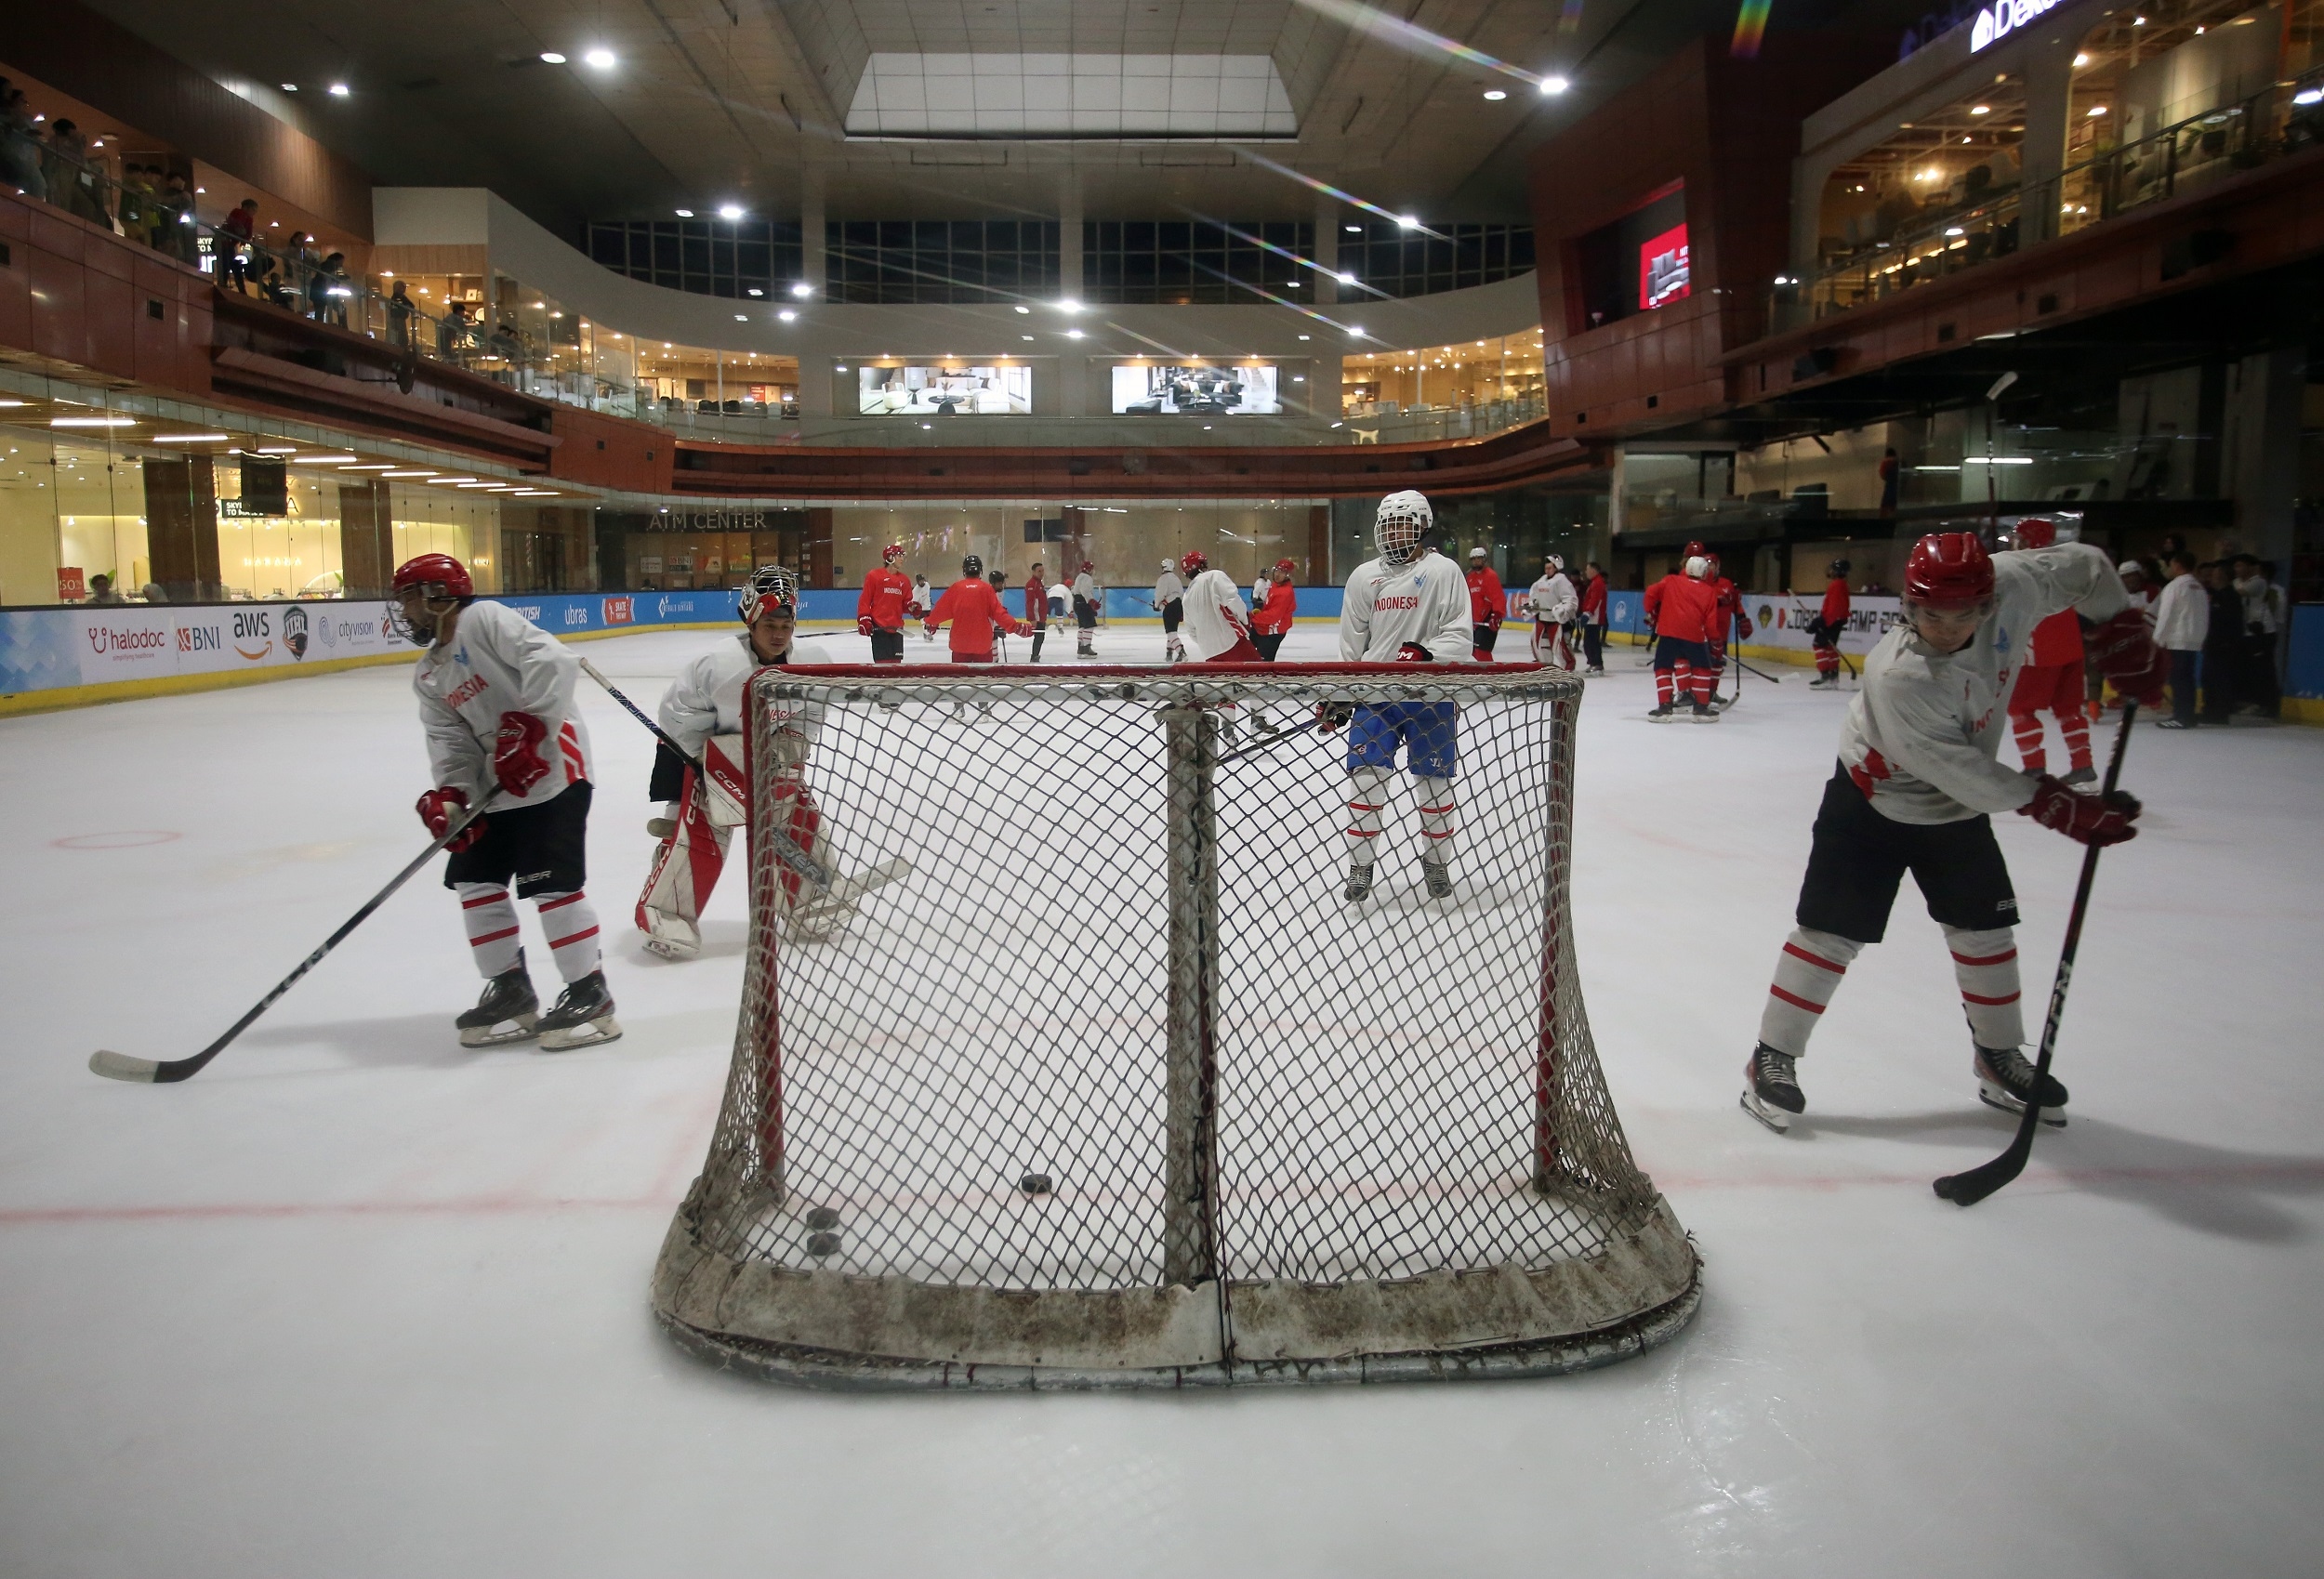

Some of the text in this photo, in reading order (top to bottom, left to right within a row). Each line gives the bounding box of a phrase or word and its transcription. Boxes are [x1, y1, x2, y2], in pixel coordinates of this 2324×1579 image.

[649, 512, 767, 530] ATM CENTER
[233, 612, 270, 638] aws
[564, 604, 588, 625] ubras
[110, 627, 165, 651] halodoc
[192, 626, 220, 651] BNI
[338, 620, 375, 641] cityvision
[714, 769, 746, 800] CCM
